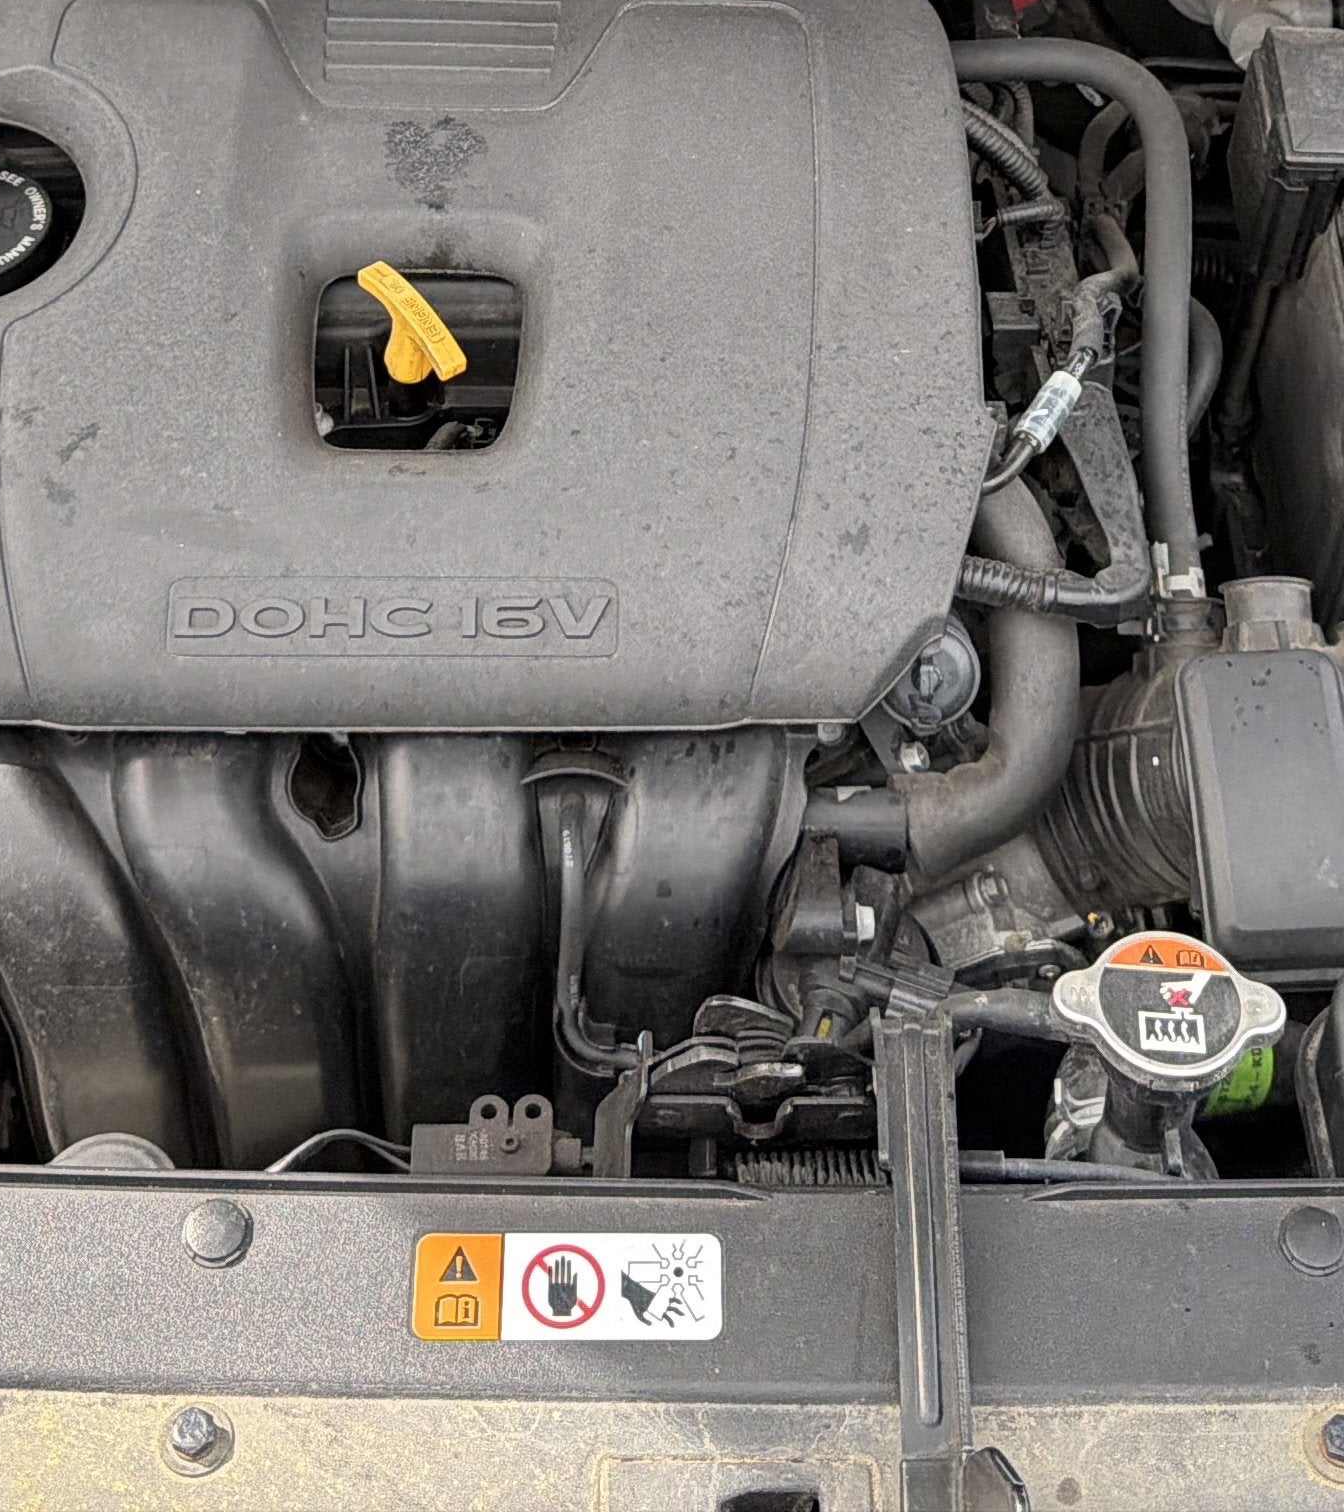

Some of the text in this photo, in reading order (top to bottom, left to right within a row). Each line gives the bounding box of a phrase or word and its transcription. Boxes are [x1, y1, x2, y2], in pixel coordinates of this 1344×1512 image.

[24, 186, 47, 231] OWNER'S
[173, 596, 612, 640] DOHC 16V
